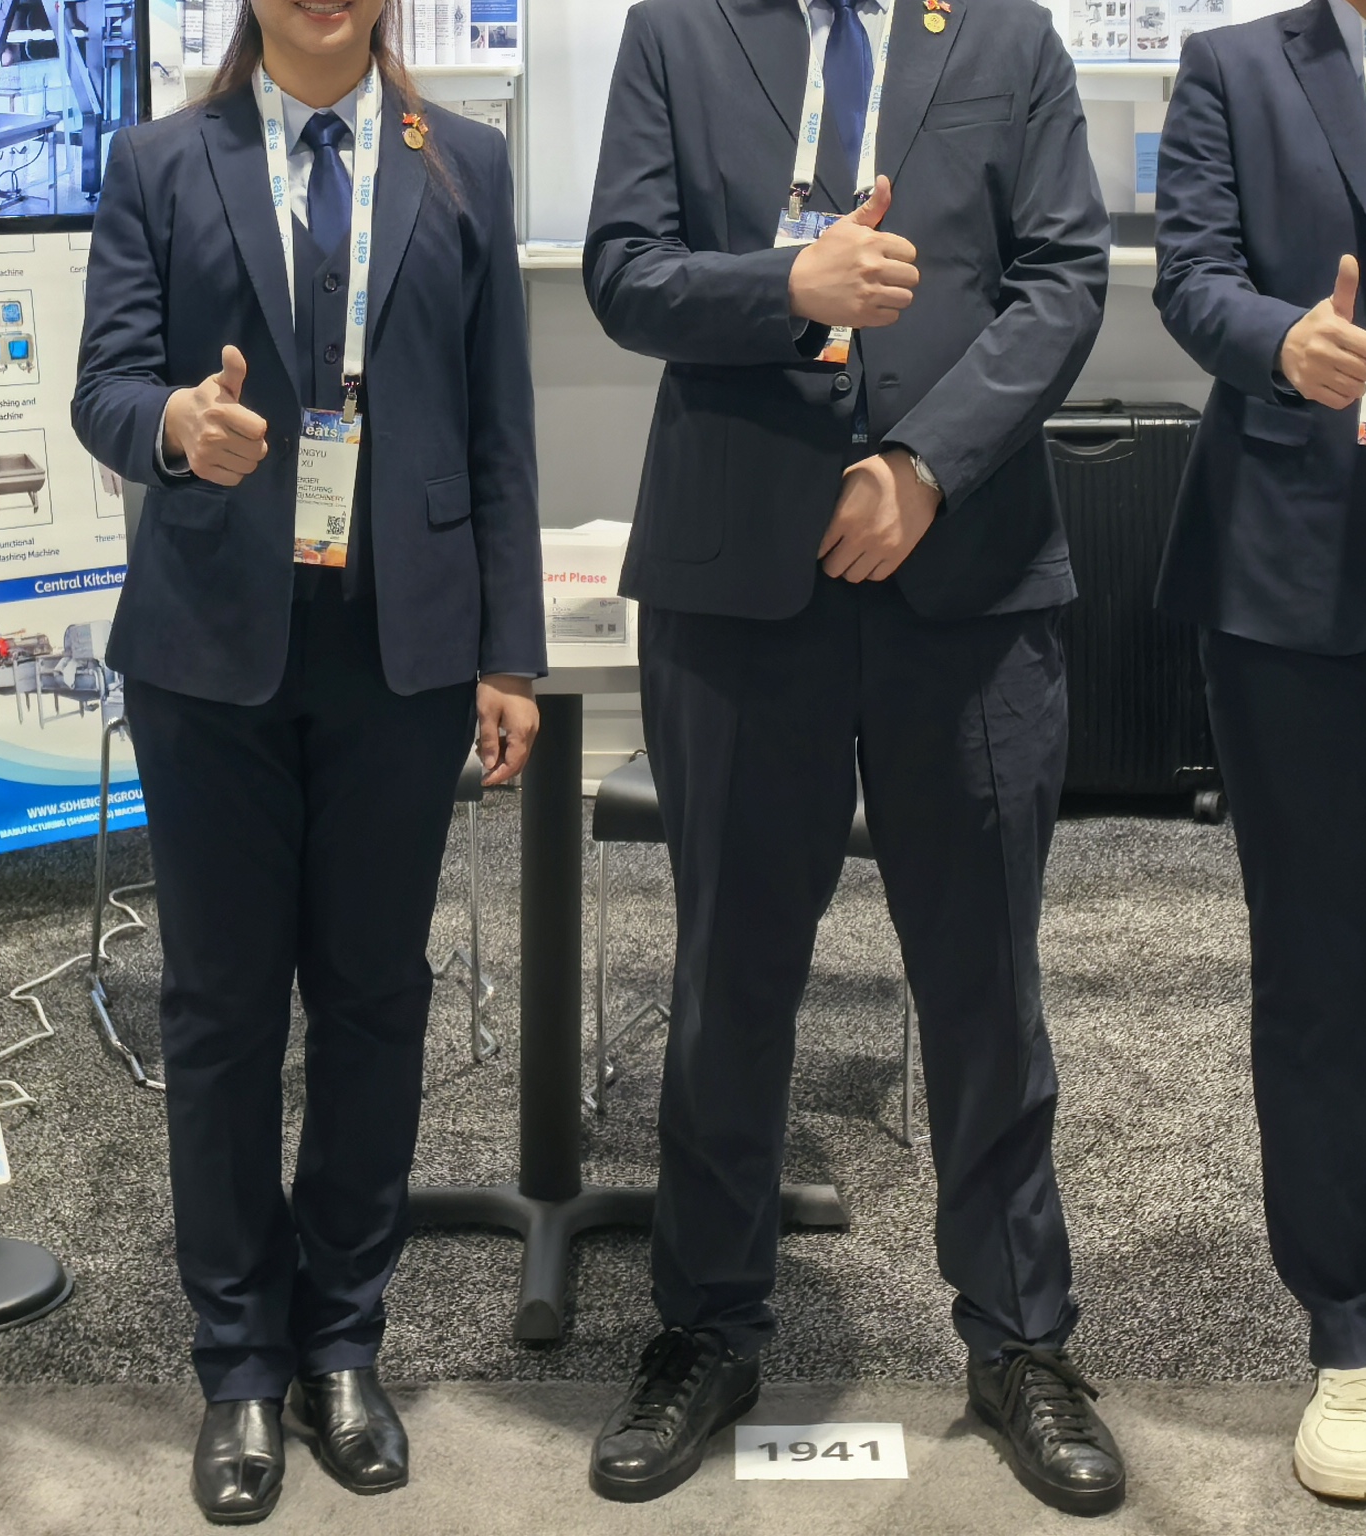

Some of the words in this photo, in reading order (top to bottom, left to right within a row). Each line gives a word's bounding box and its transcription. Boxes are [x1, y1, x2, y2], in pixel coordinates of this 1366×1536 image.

[267, 118, 278, 151] eats
[362, 118, 373, 150] eats
[807, 113, 819, 144] eats
[272, 175, 283, 207] eats
[359, 175, 370, 207] eats
[358, 231, 368, 264] eats
[354, 290, 366, 326] eats
[22, 398, 35, 407] and
[306, 426, 338, 439] eats
[28, 548, 60, 558] Machine
[35, 574, 82, 594] Central
[570, 572, 607, 584] Please
[27, 787, 144, 819] WWW.SDHENGRGROU
[758, 1441, 880, 1462] 1941
